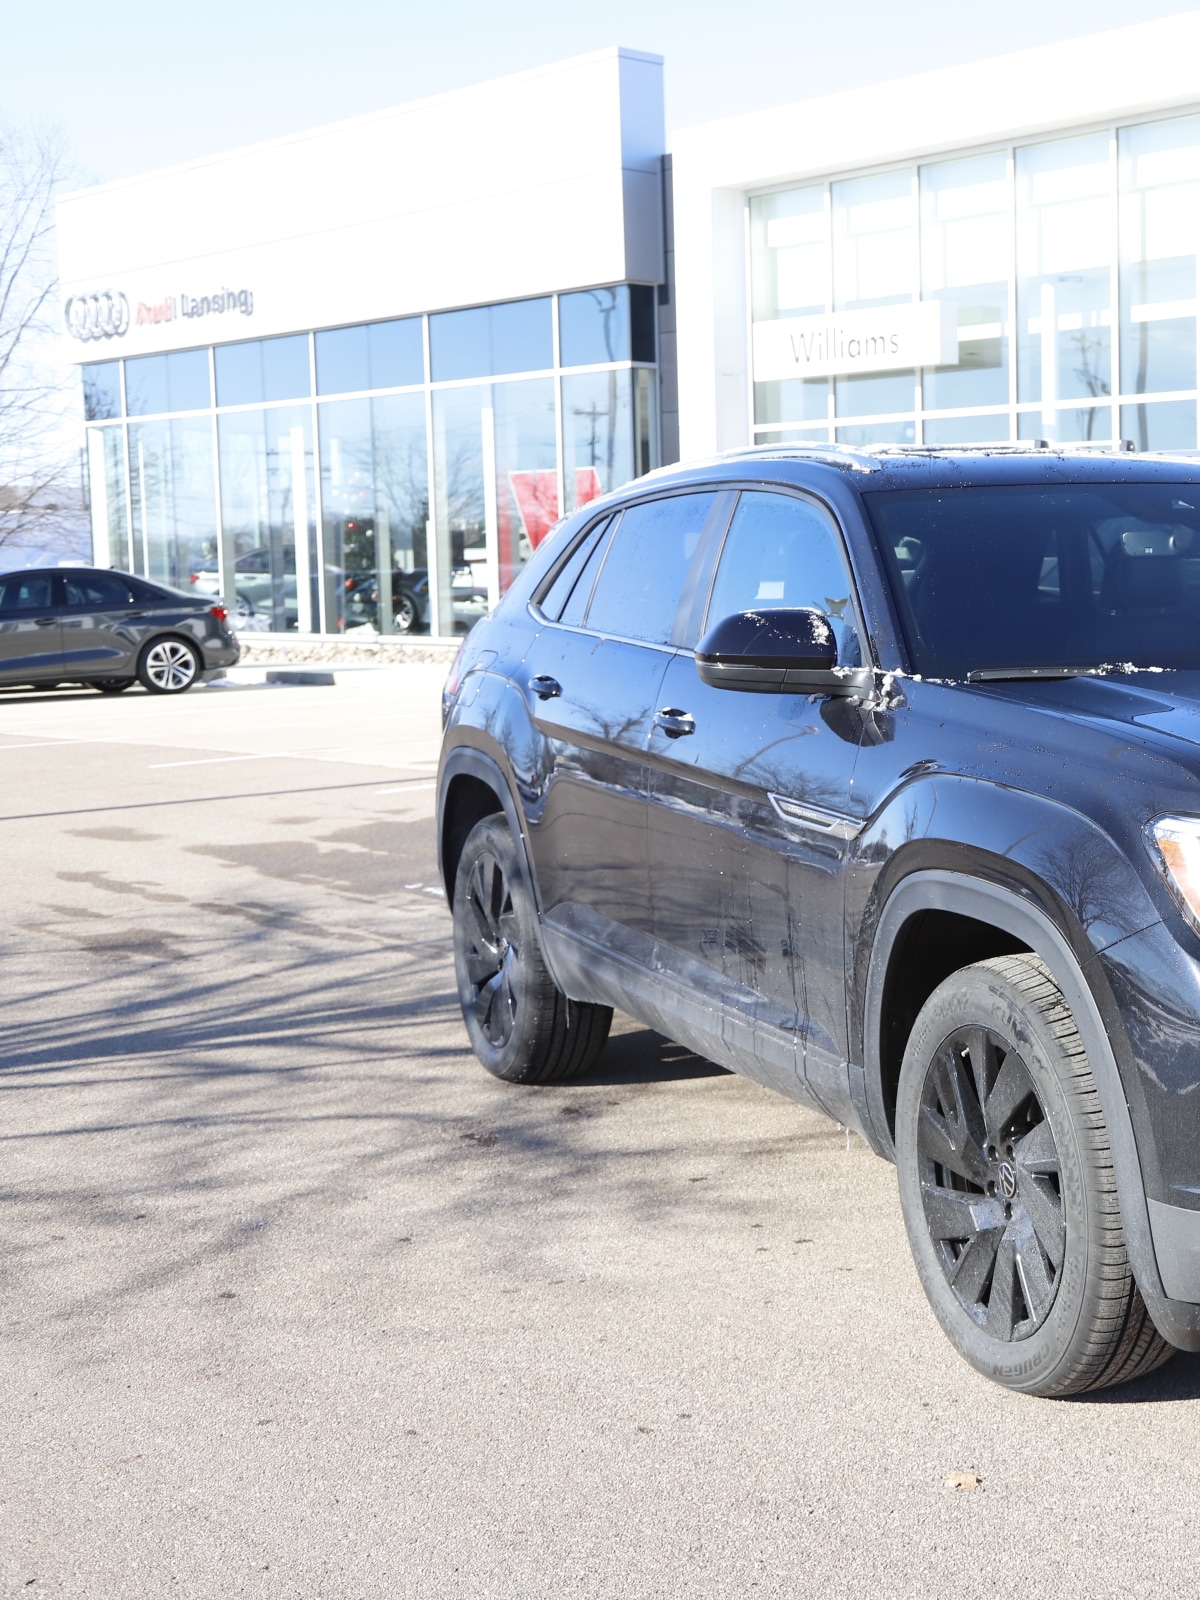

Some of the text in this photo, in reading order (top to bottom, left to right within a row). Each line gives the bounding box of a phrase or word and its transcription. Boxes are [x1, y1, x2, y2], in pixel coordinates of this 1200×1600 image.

[136, 287, 253, 326] Audi Lansing
[790, 327, 899, 363] Williams
[992, 1343, 1050, 1378] CRUGEN
